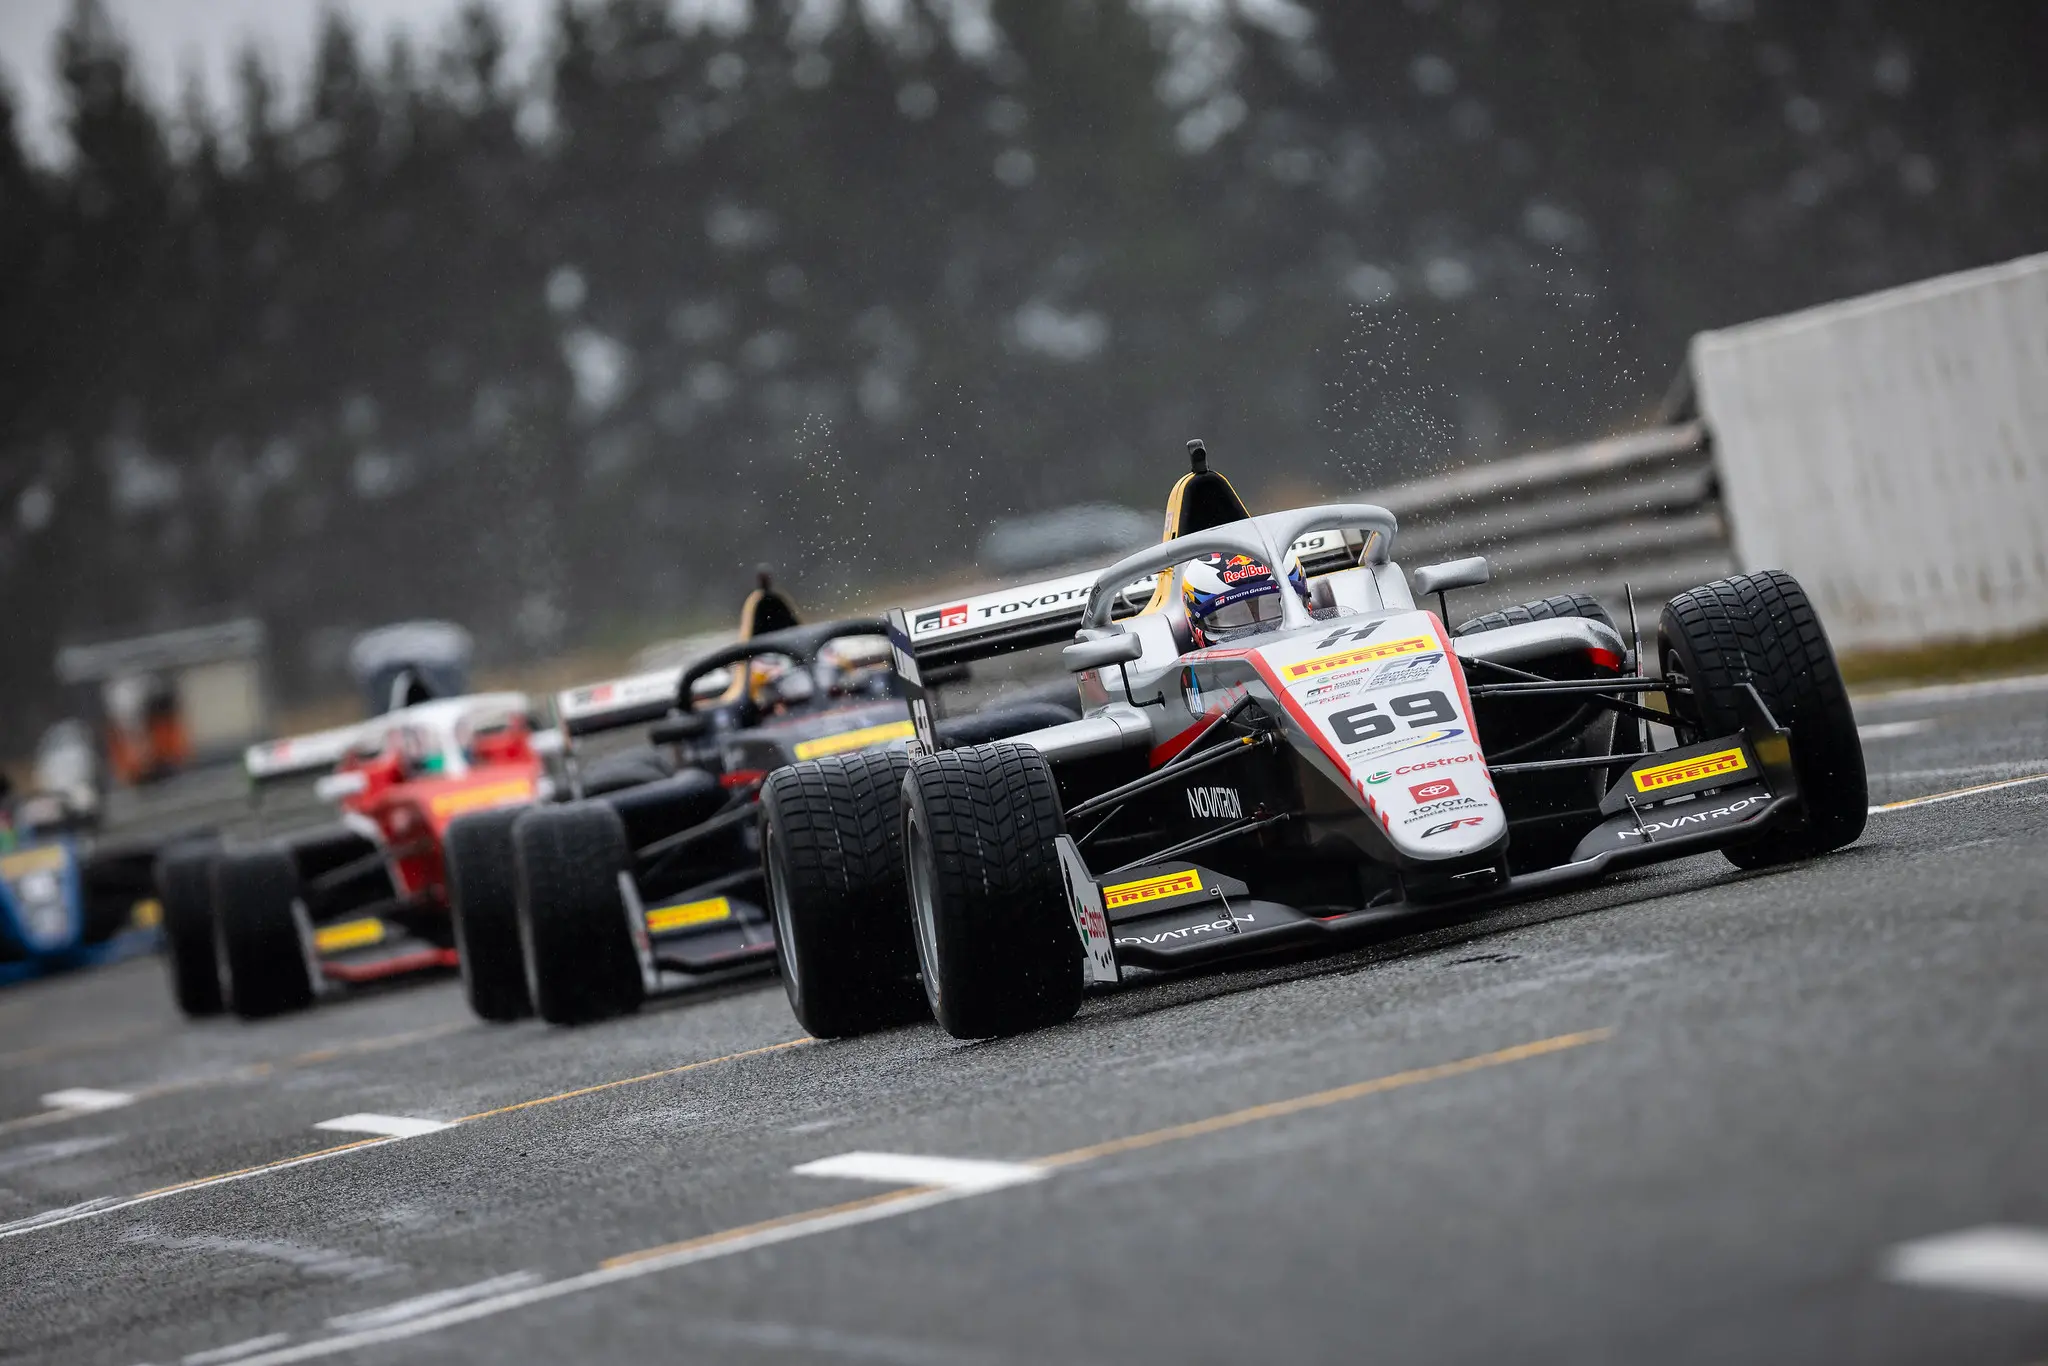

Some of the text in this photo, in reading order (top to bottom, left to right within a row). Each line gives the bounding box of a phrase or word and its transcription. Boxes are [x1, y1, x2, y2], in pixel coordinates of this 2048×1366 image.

[1223, 569, 1248, 583] Red
[1226, 590, 1250, 601] TOYOTA
[1249, 585, 1272, 594] GAZOO
[1290, 638, 1426, 677] PIRELLI
[1331, 667, 1370, 680] Castrol
[1327, 690, 1458, 745] 69
[1395, 753, 1474, 775] Castrol
[1640, 755, 1738, 788] PIRELLI
[1186, 786, 1243, 819] NOVATRON
[1403, 802, 1488, 825] Financial Services
[1409, 797, 1476, 816] TOYOTA
[1617, 792, 1772, 840] NOVATRON
